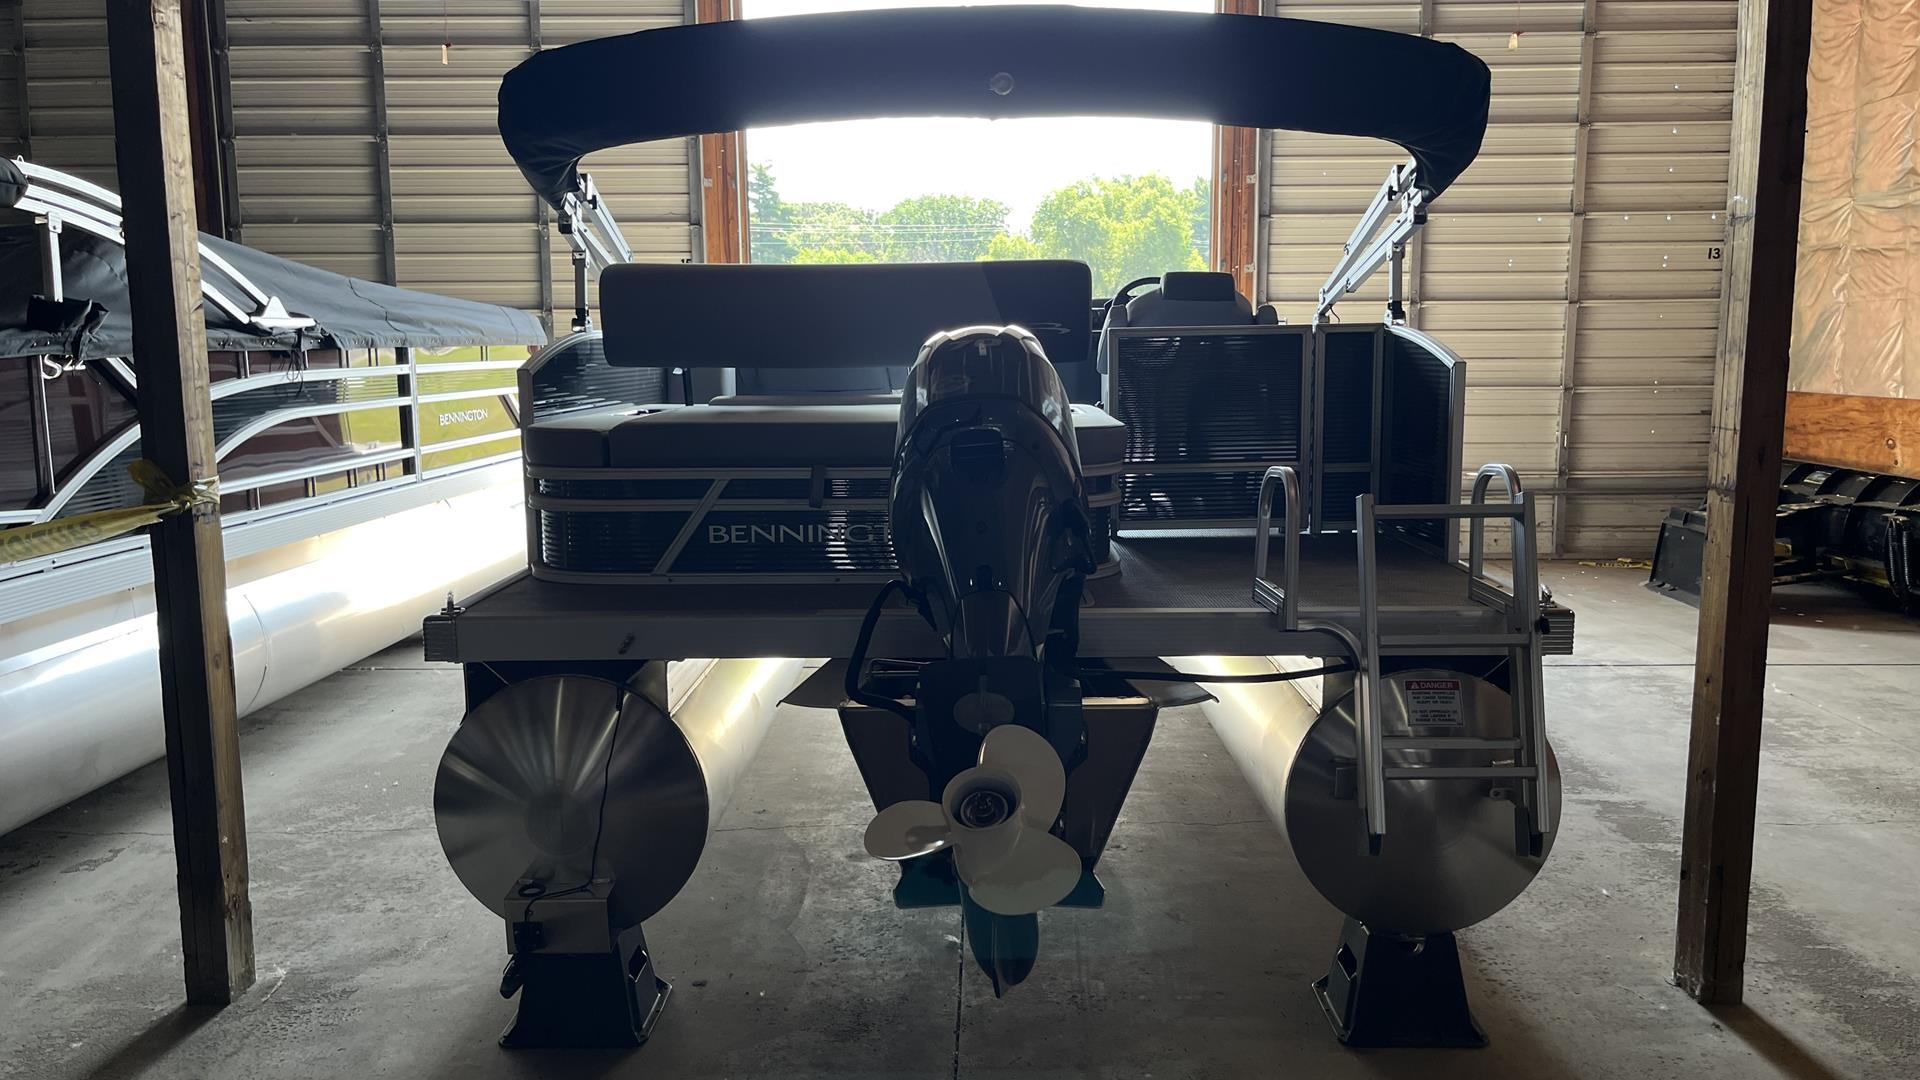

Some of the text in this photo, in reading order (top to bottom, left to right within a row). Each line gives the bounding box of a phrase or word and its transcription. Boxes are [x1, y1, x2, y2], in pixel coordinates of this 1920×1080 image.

[1707, 247, 1721, 260] 13
[438, 408, 488, 427] BENNINGTON
[708, 524, 890, 544] BENNINGT
[1420, 681, 1454, 689] DANGER
